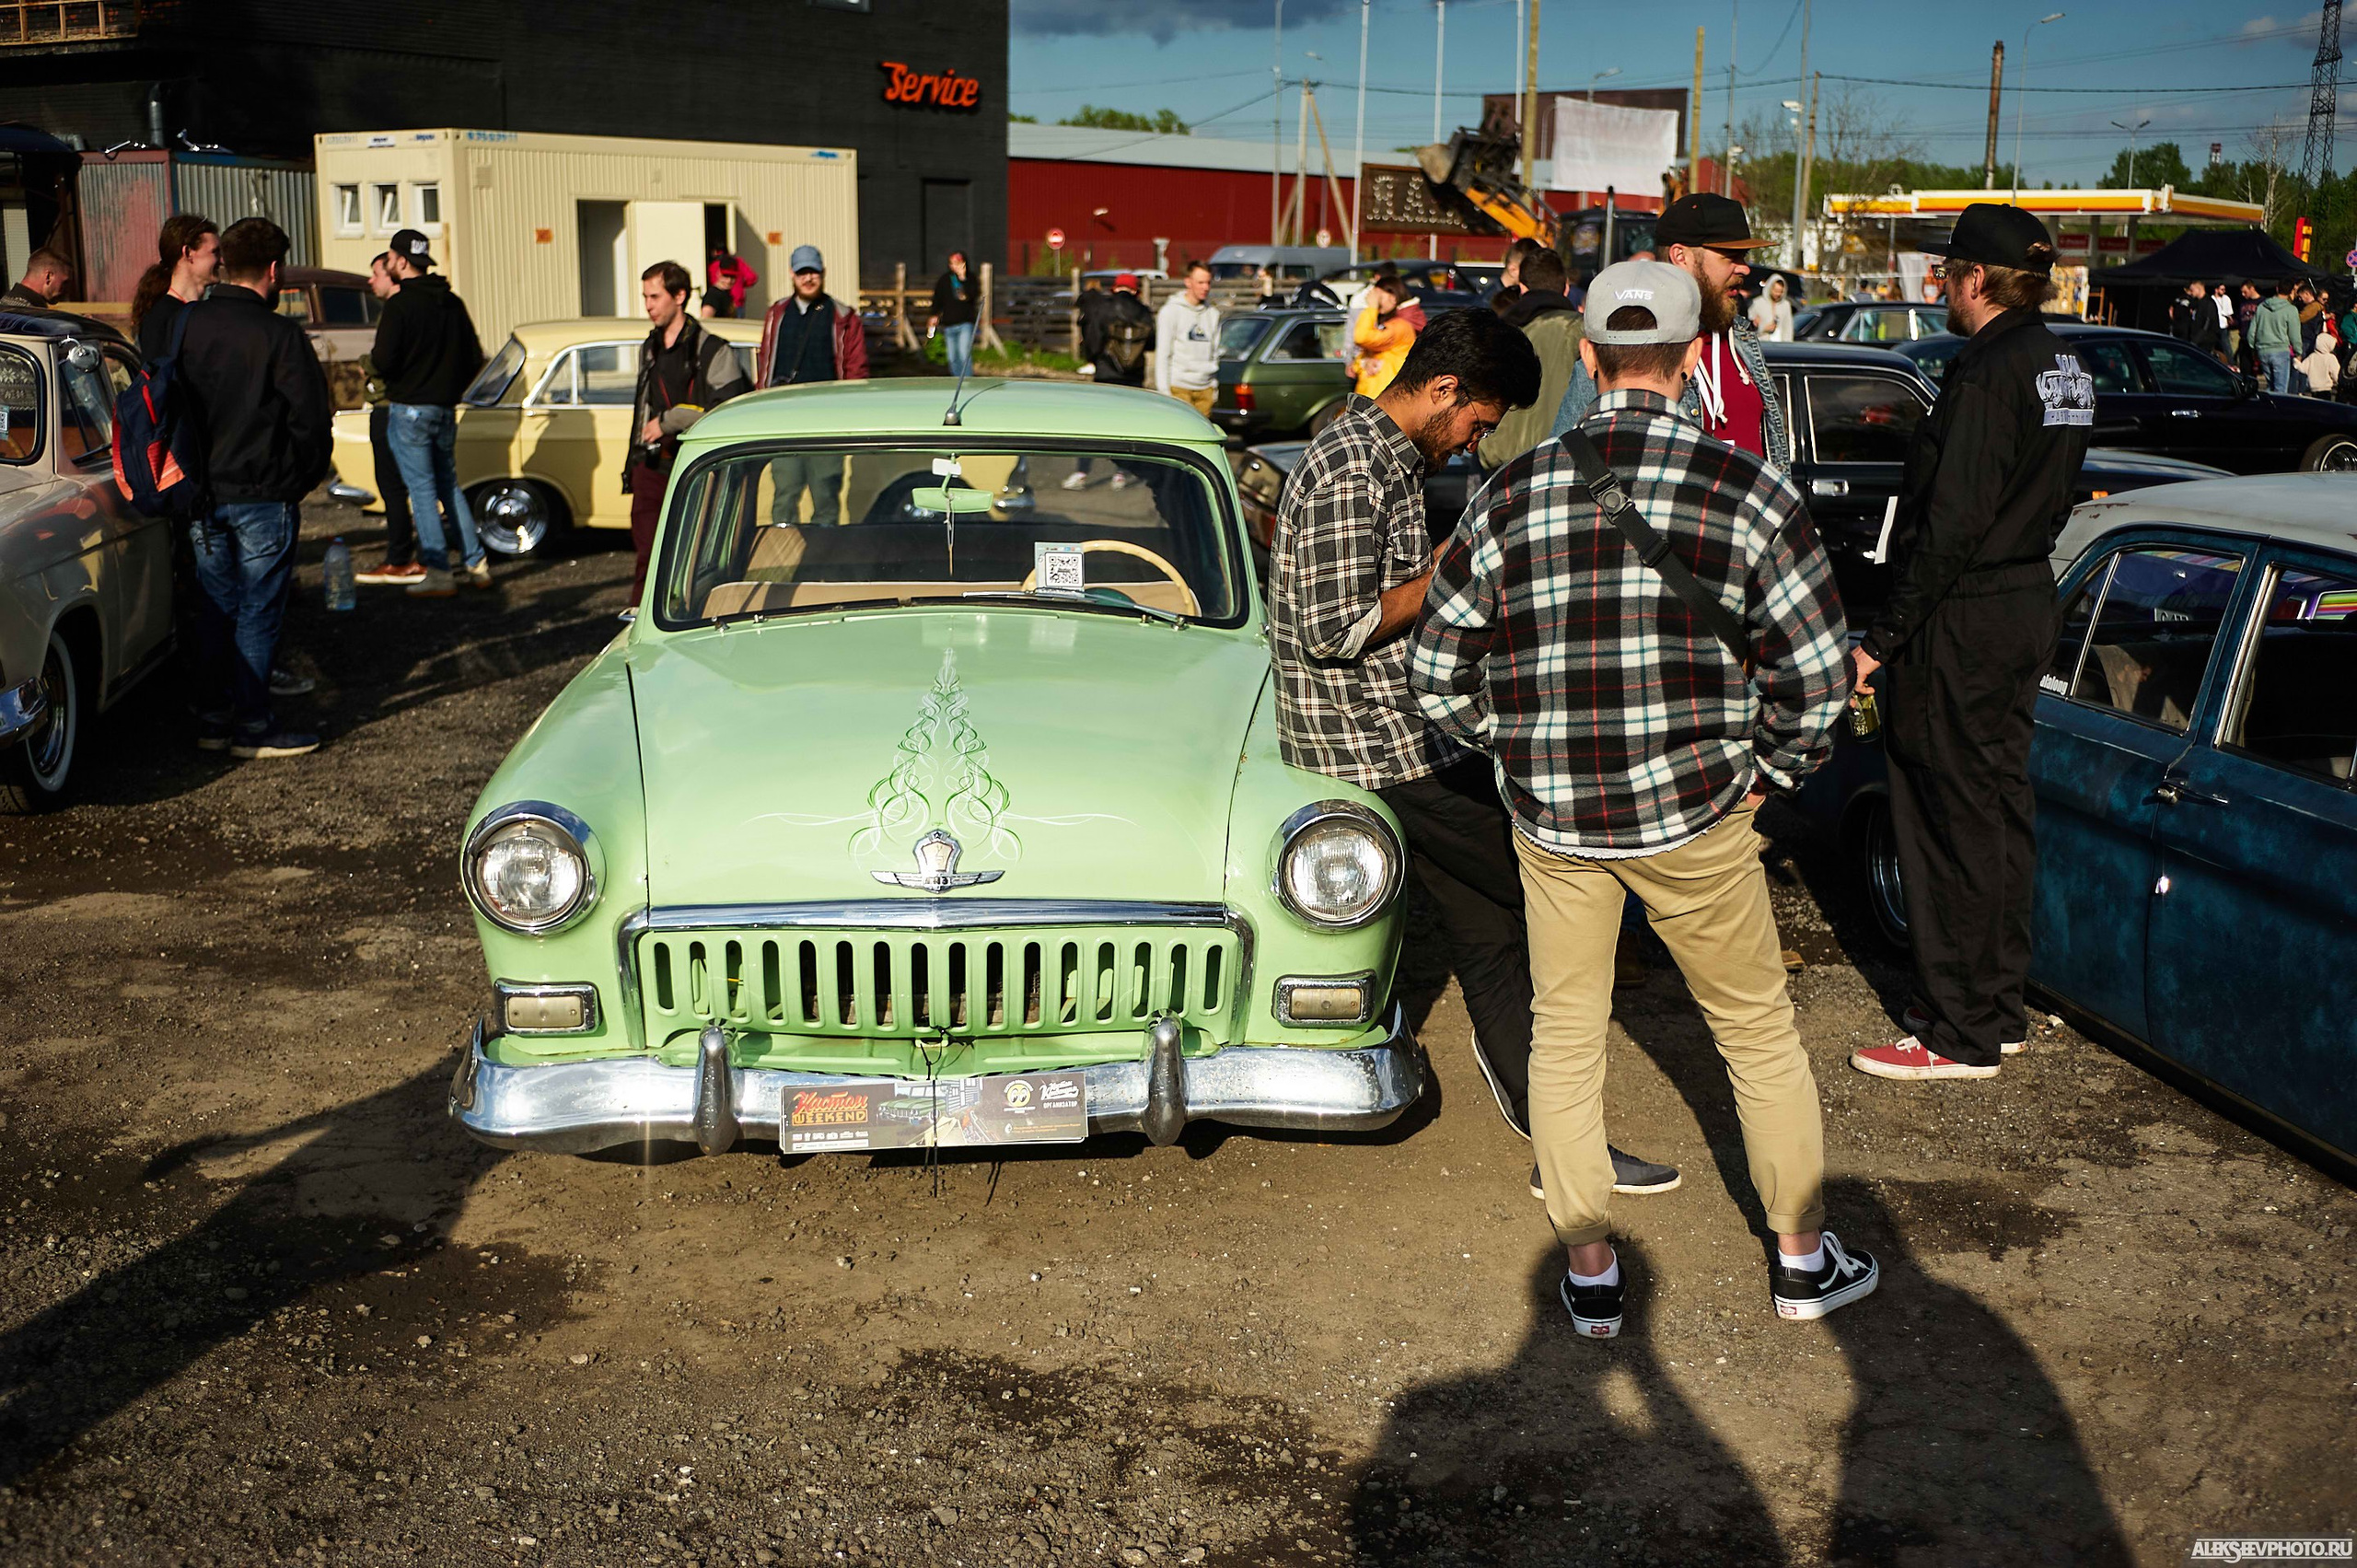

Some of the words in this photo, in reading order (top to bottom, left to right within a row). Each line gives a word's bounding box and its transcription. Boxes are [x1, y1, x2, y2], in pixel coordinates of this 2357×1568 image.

[881, 61, 979, 107] Service
[1614, 289, 1654, 300] VANS
[794, 1110, 867, 1125] WEEKEND
